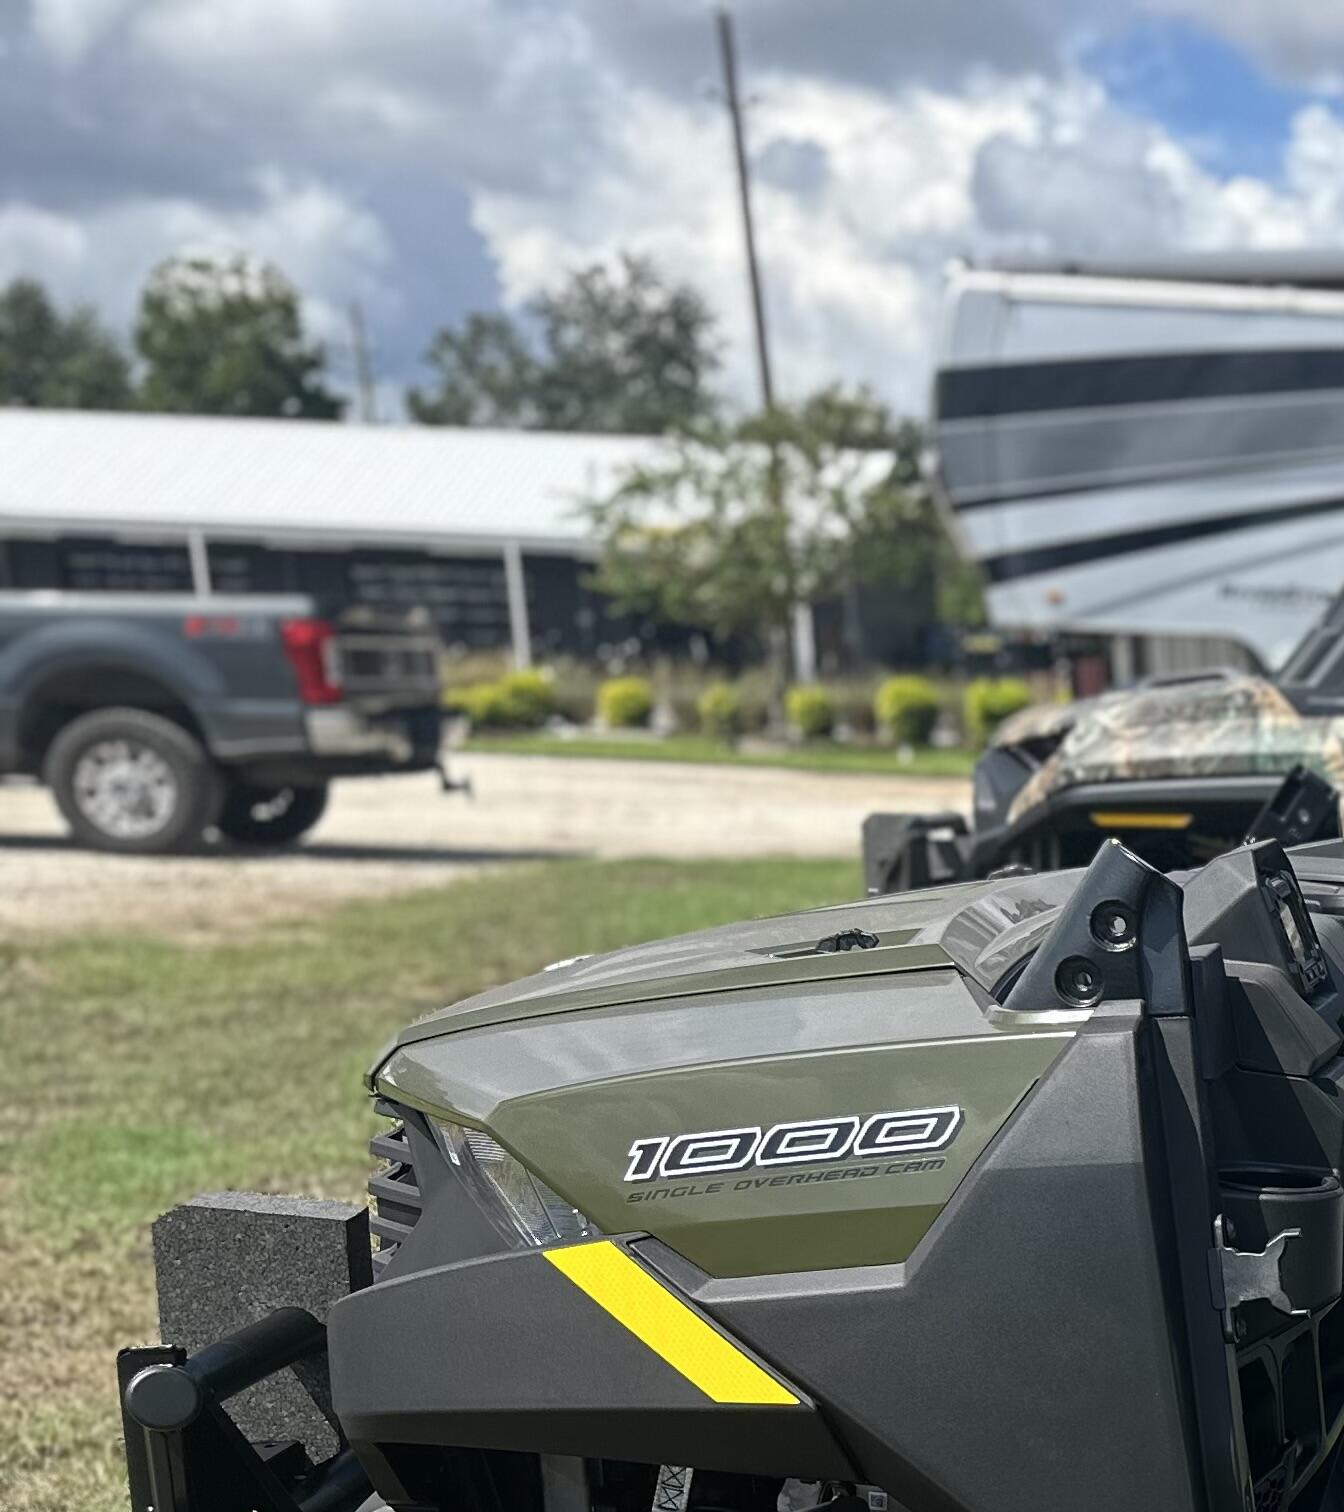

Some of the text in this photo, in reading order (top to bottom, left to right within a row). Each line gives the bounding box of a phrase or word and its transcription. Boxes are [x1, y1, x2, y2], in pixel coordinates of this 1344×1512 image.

[624, 1105, 964, 1183] 1000
[626, 1157, 946, 1204] SINGLE OVERHEAD CAM
